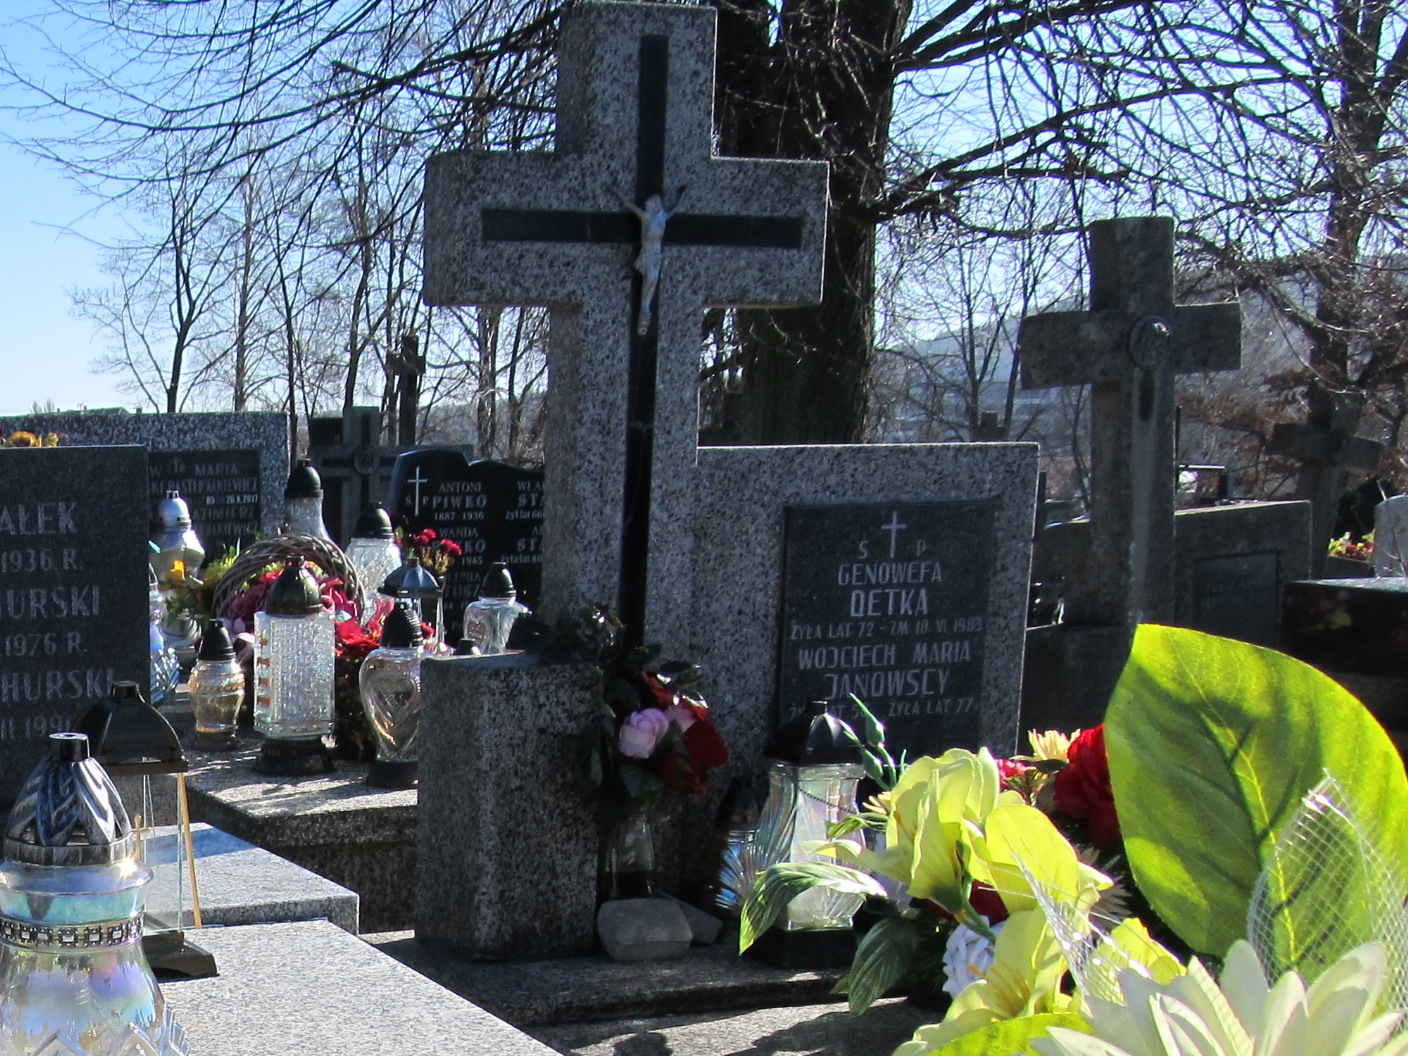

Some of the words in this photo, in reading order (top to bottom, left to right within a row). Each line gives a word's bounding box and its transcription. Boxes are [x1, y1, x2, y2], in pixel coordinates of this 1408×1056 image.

[195, 463, 239, 477] MARIA
[439, 482, 481, 493] ANTONI
[432, 494, 487, 509] PIWKO
[440, 526, 478, 538] WANDA
[838, 561, 942, 586] GENOWEFA
[850, 588, 929, 617] DETKA
[828, 622, 852, 639] LAT
[858, 622, 874, 638] 72
[798, 645, 896, 670] WOJCIECH
[912, 641, 971, 664] MARIA
[824, 668, 950, 700] JANOWSCY
[927, 697, 950, 715] LAT
